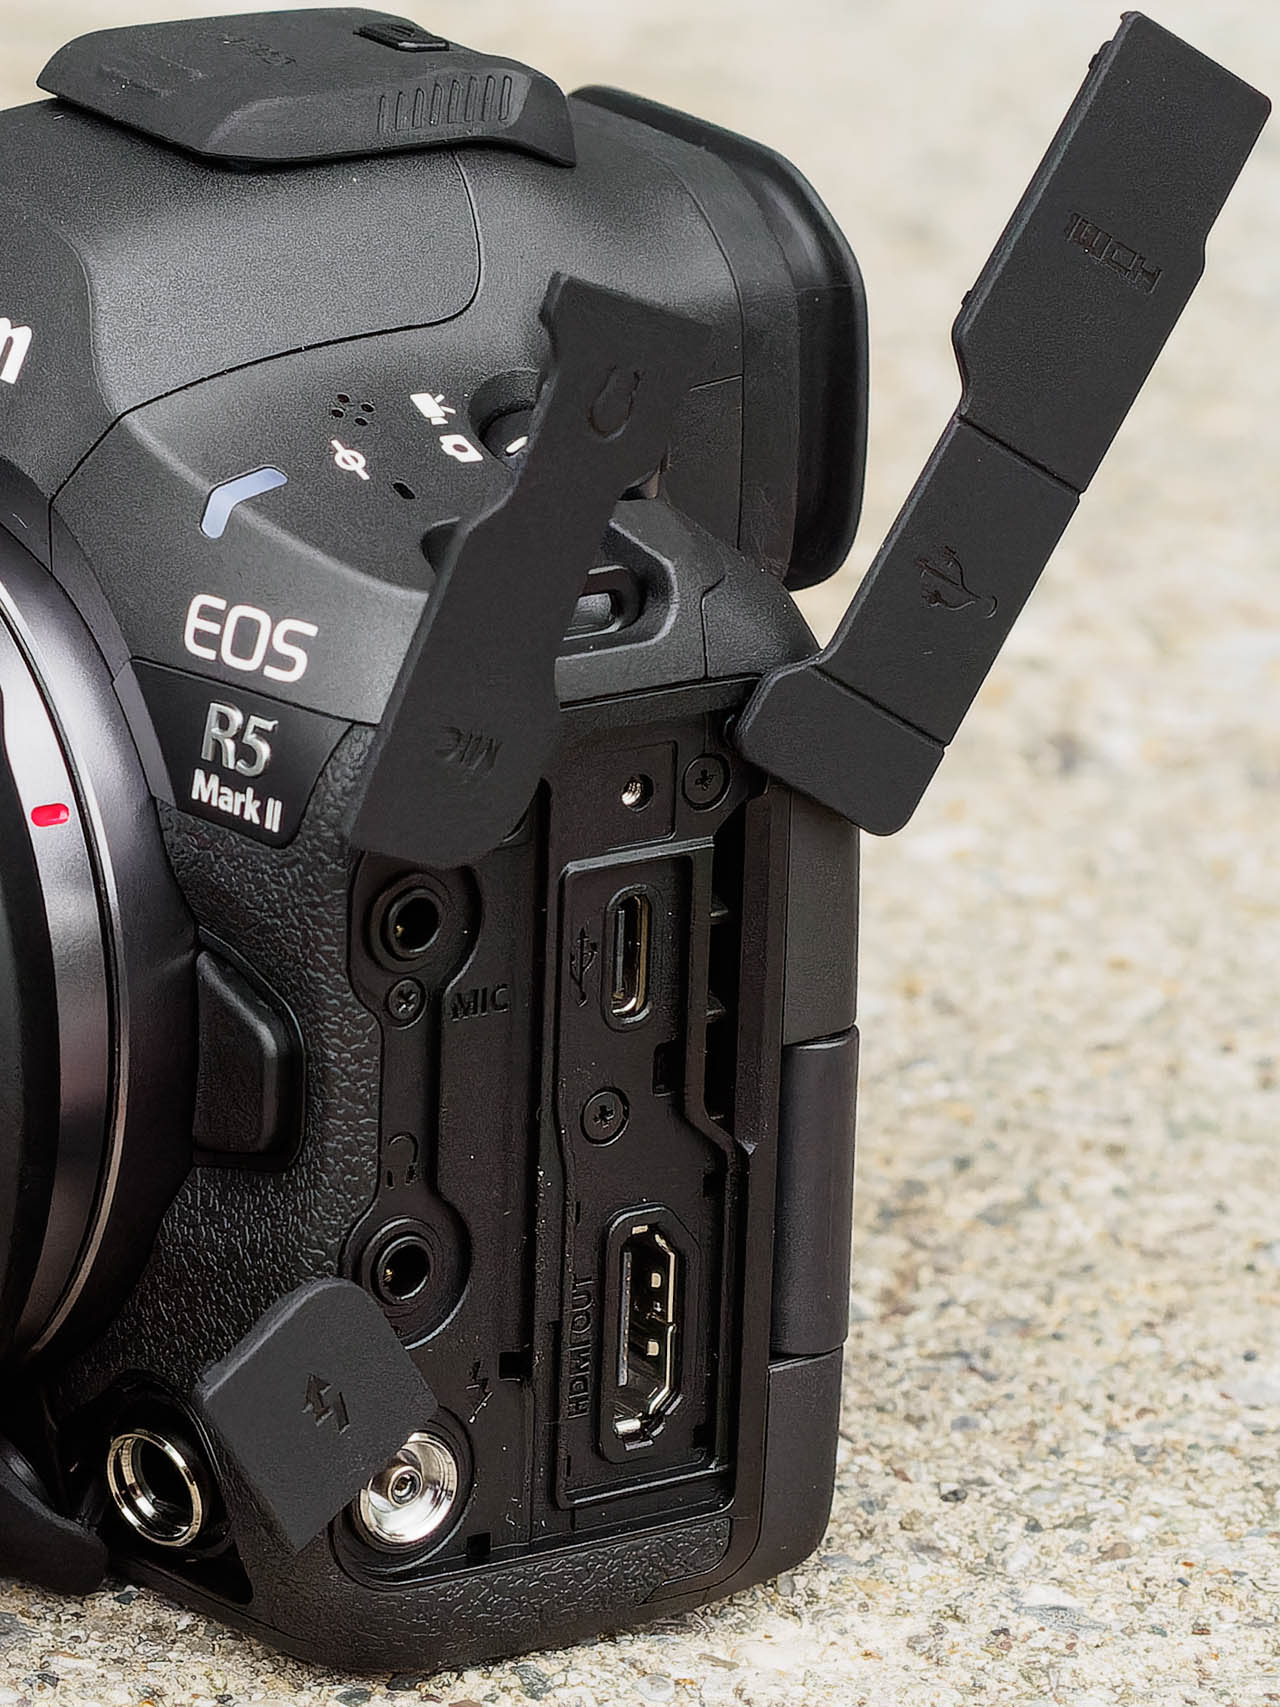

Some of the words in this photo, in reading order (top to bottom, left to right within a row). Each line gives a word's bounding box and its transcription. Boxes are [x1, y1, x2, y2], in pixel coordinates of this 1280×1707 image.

[1065, 212, 1163, 295] HDMI
[183, 593, 319, 683] EOS
[200, 701, 279, 778] R5
[191, 768, 262, 825] Mark
[263, 798, 283, 834] II
[451, 983, 510, 1022] MIC
[566, 1273, 596, 1335] OUT
[566, 1343, 593, 1420] HDMI
